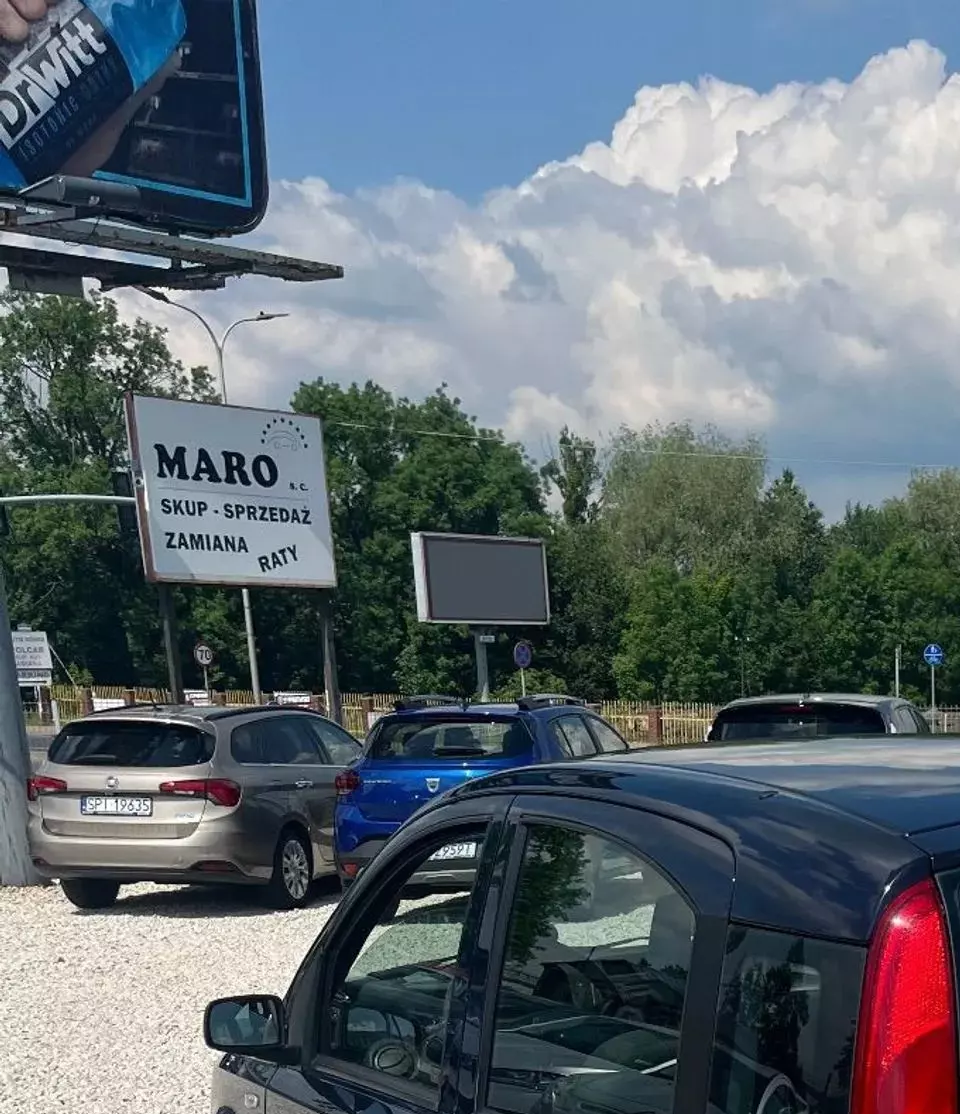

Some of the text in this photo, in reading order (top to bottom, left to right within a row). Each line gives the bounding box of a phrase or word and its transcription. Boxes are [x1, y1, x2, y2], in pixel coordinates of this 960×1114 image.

[153, 443, 278, 488] MARO
[161, 498, 208, 517] SKUP
[223, 503, 313, 525] SPRZEDAŻ
[165, 532, 249, 553] ZAMIANA
[257, 545, 298, 573] RATY
[199, 649, 211, 661] 70
[114, 799, 150, 812] 19635
